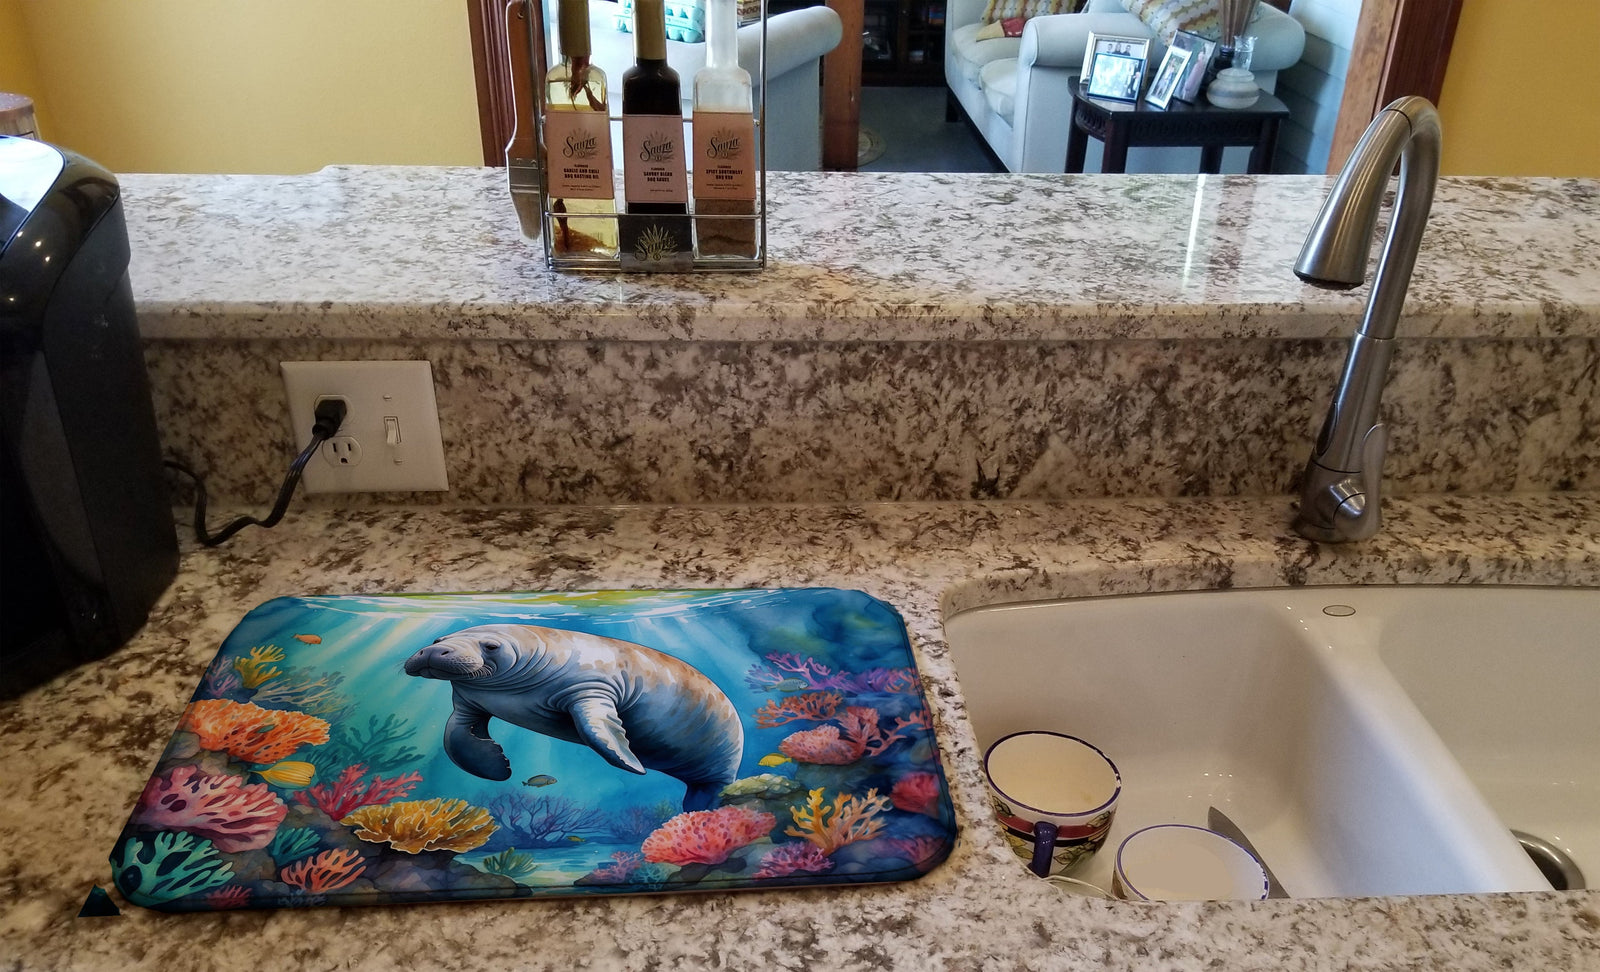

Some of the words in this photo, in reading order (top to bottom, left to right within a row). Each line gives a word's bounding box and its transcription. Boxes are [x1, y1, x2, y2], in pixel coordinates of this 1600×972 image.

[563, 135, 598, 158] Sauza
[640, 140, 673, 161] Sauza
[706, 136, 741, 159] Sauza
